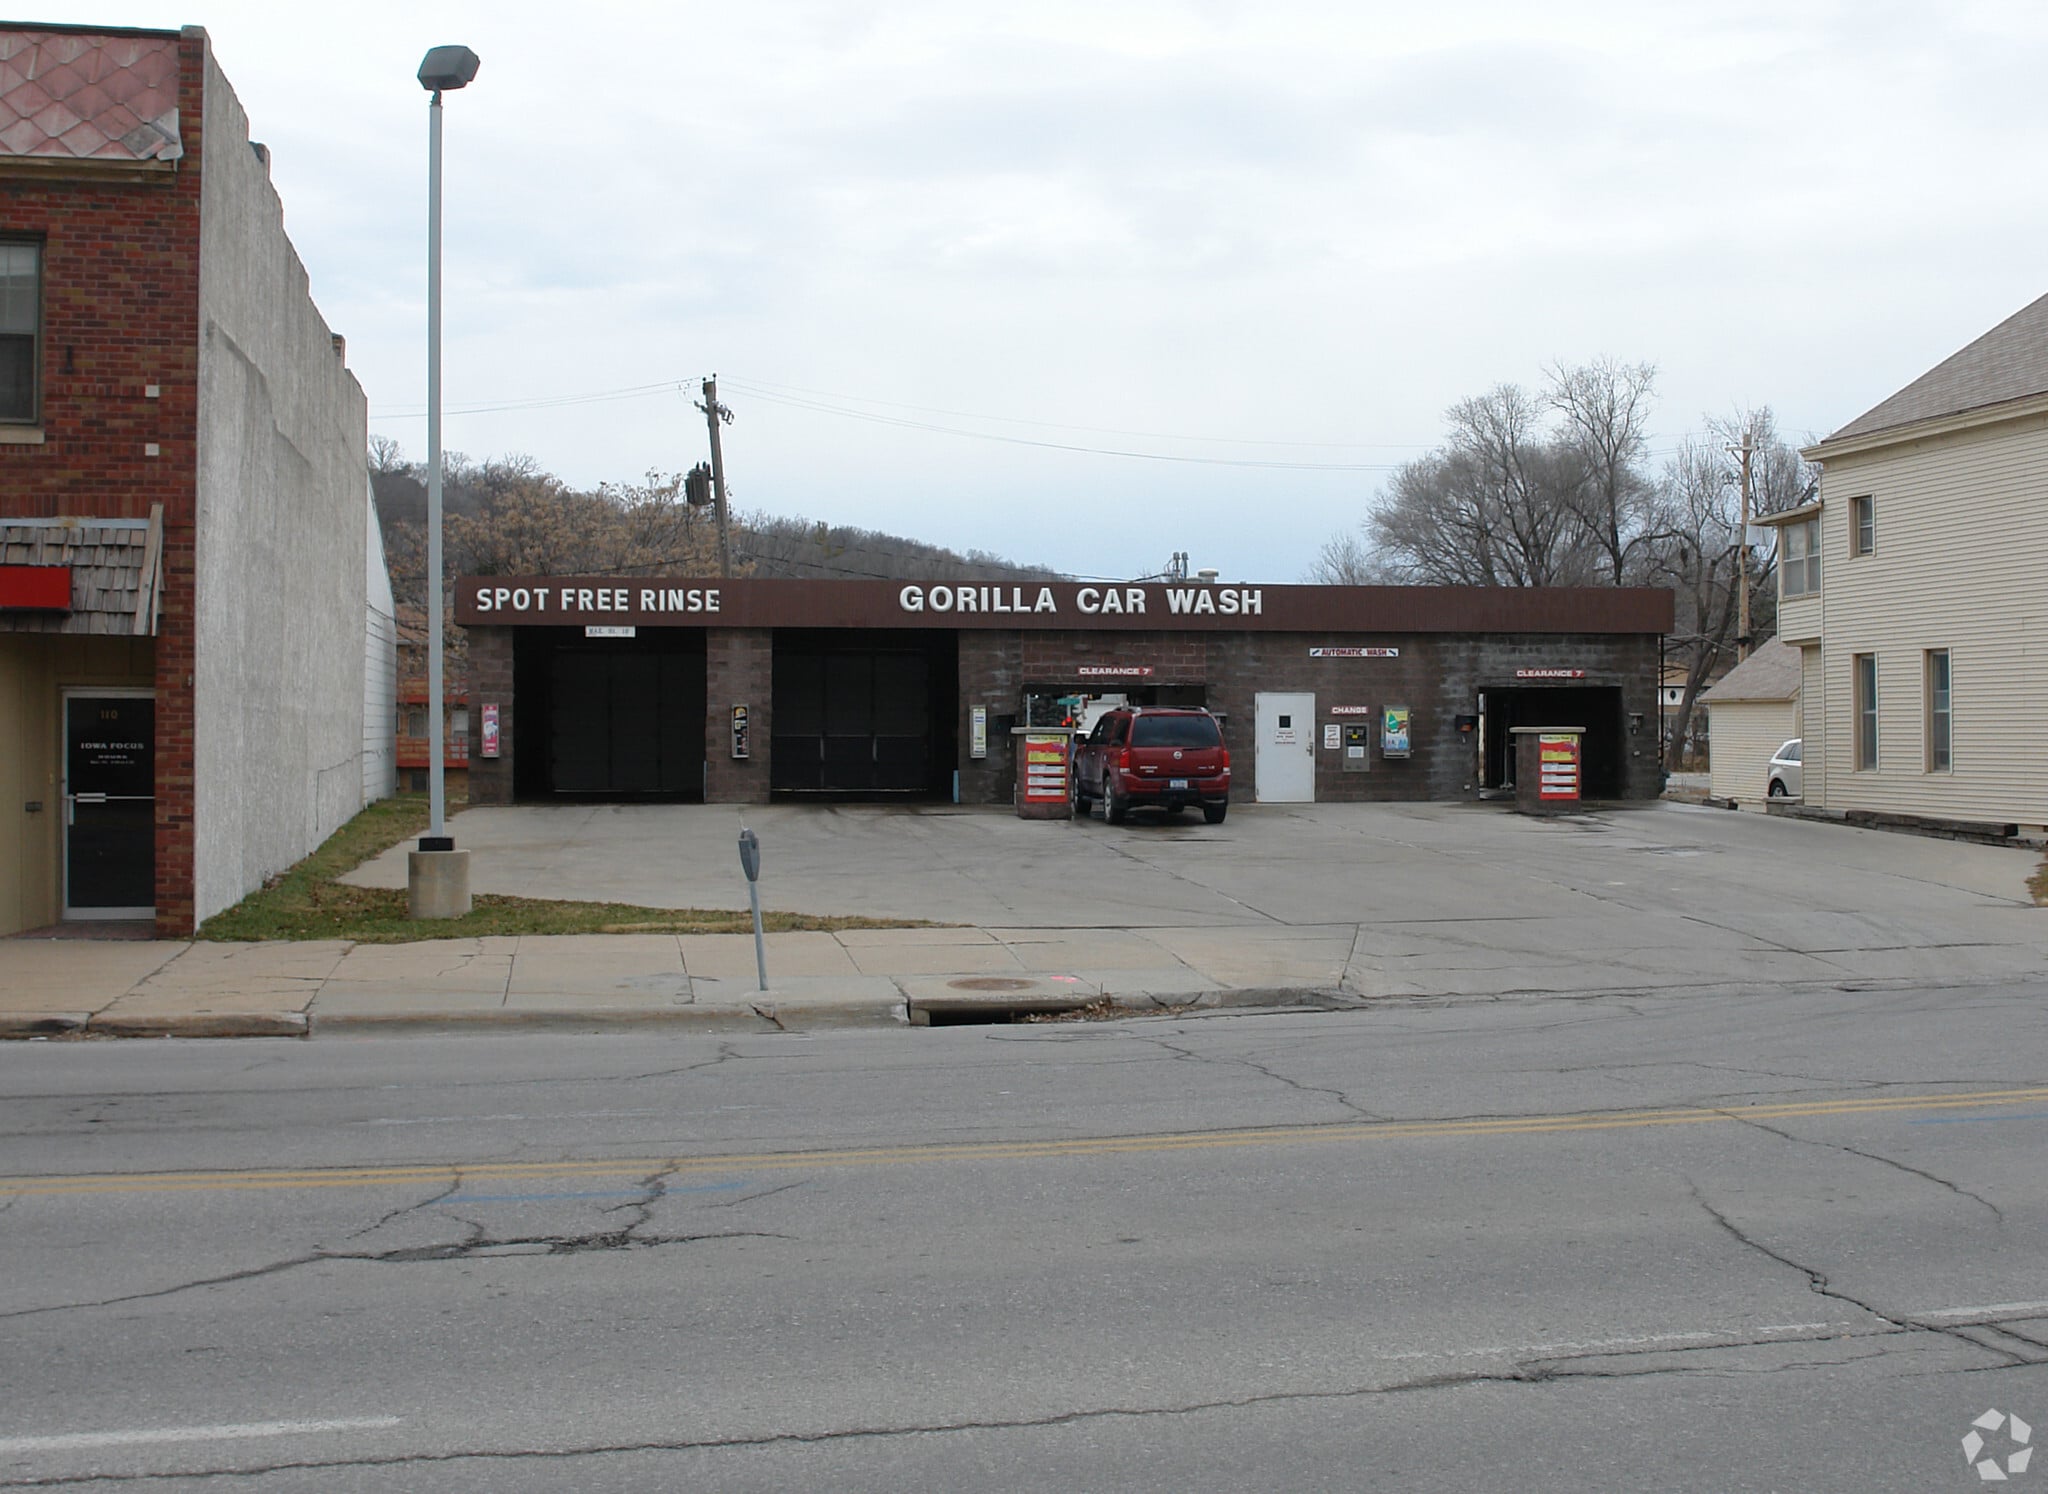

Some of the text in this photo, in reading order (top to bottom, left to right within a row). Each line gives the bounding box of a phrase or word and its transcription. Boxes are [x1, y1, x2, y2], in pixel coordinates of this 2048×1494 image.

[476, 588, 720, 612] SPOT FREE RINSE
[899, 585, 1262, 615] GORILLA CAR WASH
[1321, 648, 1387, 656] AUTOMATIC WASH
[1079, 667, 1140, 675] CLEARANCE
[1516, 669, 1573, 677] CLEARANCE
[101, 710, 118, 719] 110
[81, 742, 144, 750] IOWA FOCUS
